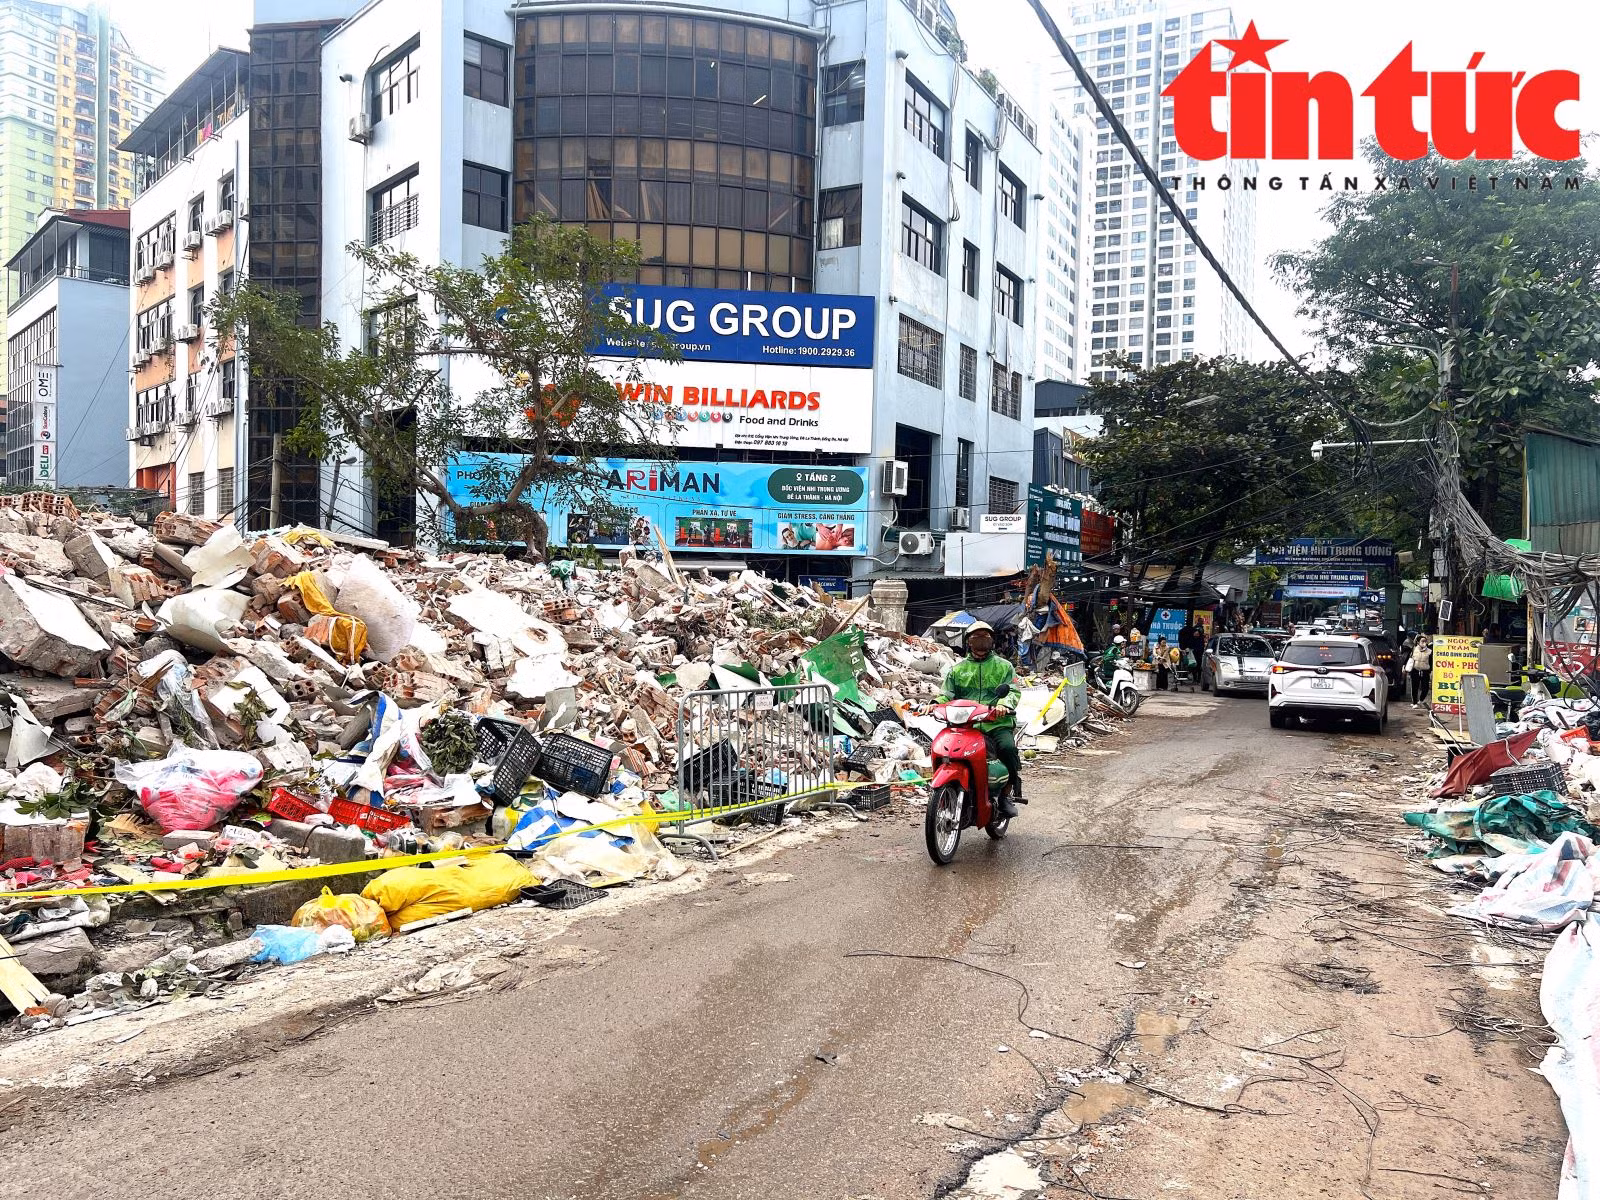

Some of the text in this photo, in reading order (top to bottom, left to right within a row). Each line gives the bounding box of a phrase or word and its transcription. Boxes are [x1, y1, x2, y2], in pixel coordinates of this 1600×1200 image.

[608, 296, 857, 341] SUG GROUP
[762, 345, 855, 357] Hotline: 1900.2929.36
[39, 371, 49, 397] OME
[615, 382, 821, 411] WIN BILLIARDS
[739, 415, 819, 427] Food and Drinks
[830, 474, 837, 482] 2
[794, 513, 818, 521] STRESS,
[1330, 546, 1362, 556] TRUNG
[1364, 545, 1392, 557] ƯƠNG
[1438, 695, 1463, 703] CH
[1434, 704, 1452, 712] 25K
